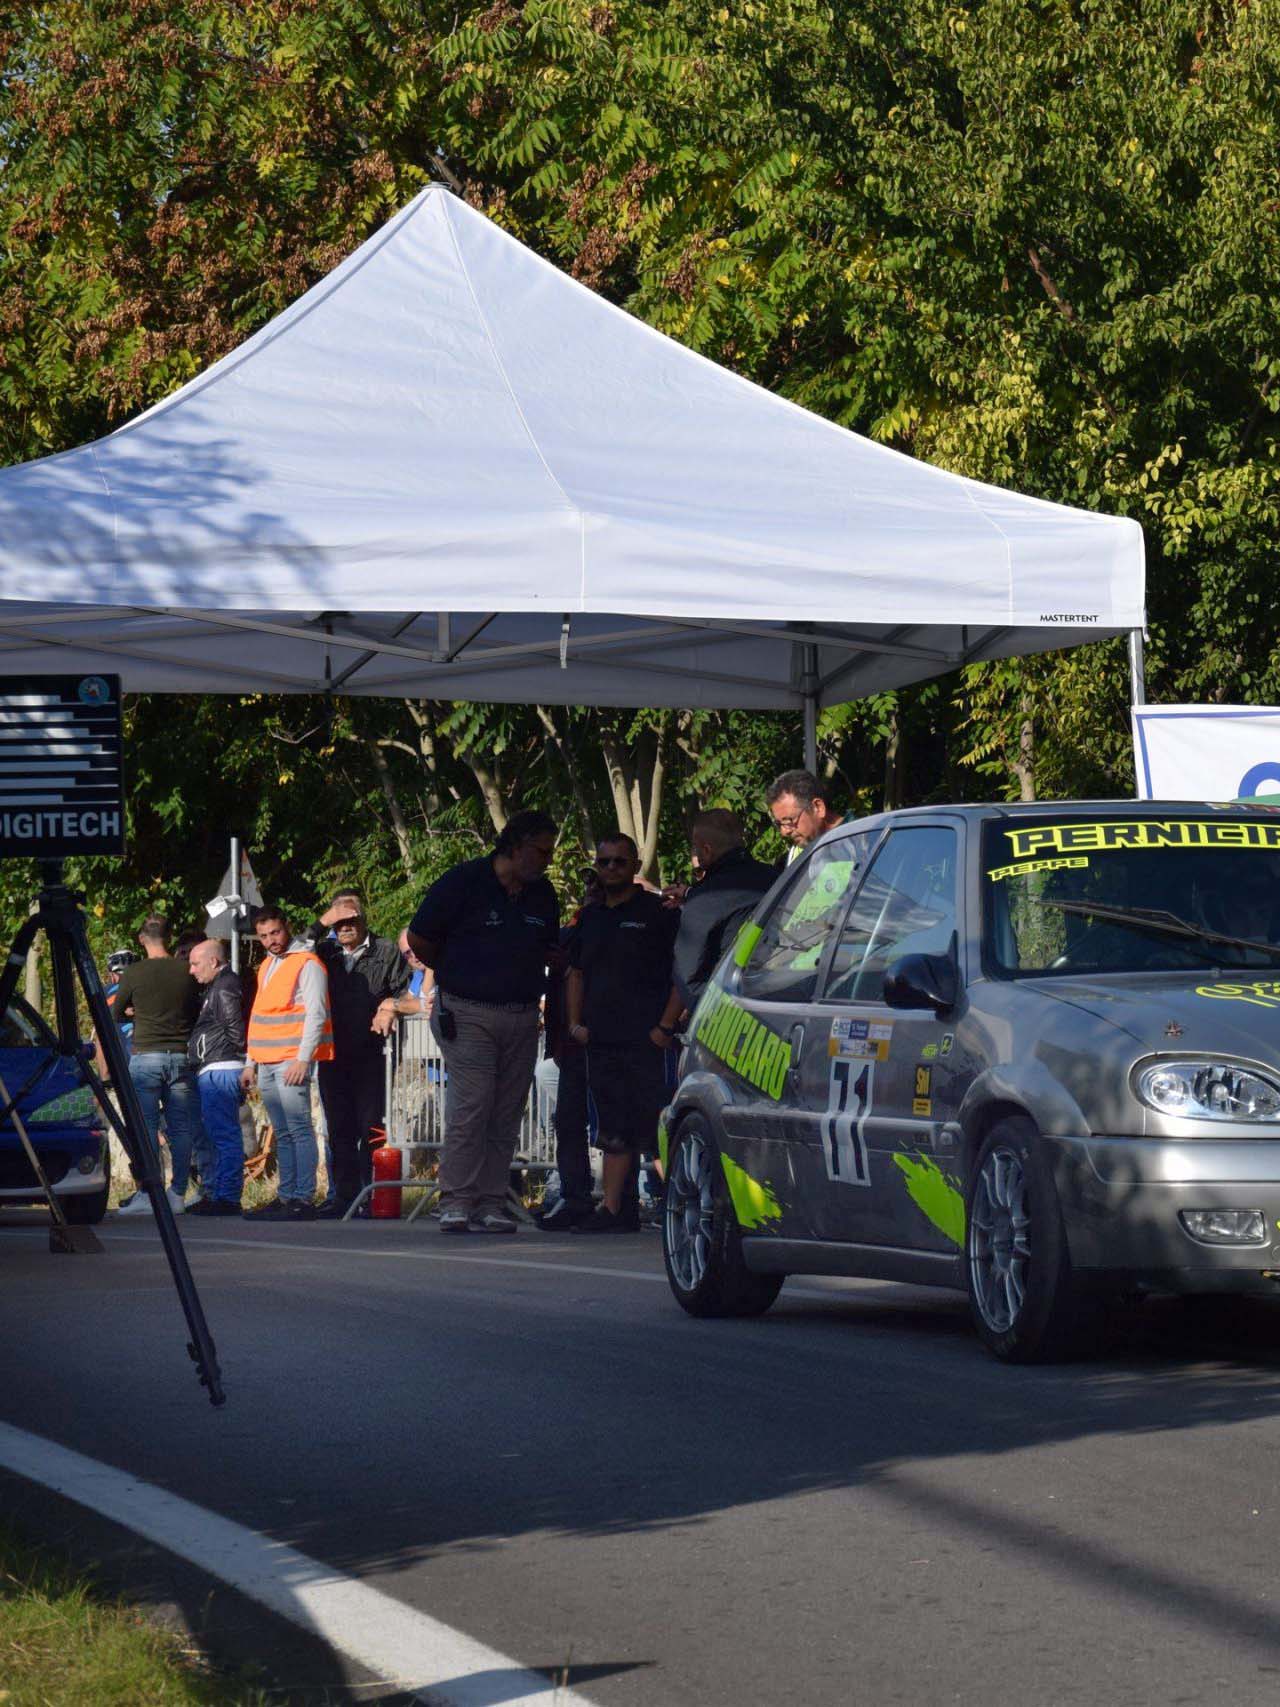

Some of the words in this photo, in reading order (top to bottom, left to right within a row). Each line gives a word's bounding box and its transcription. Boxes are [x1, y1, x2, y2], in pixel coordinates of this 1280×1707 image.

[1040, 614, 1099, 622] MASTERTENT
[0, 811, 120, 838] IGITECH
[987, 856, 1089, 882] PEPPE
